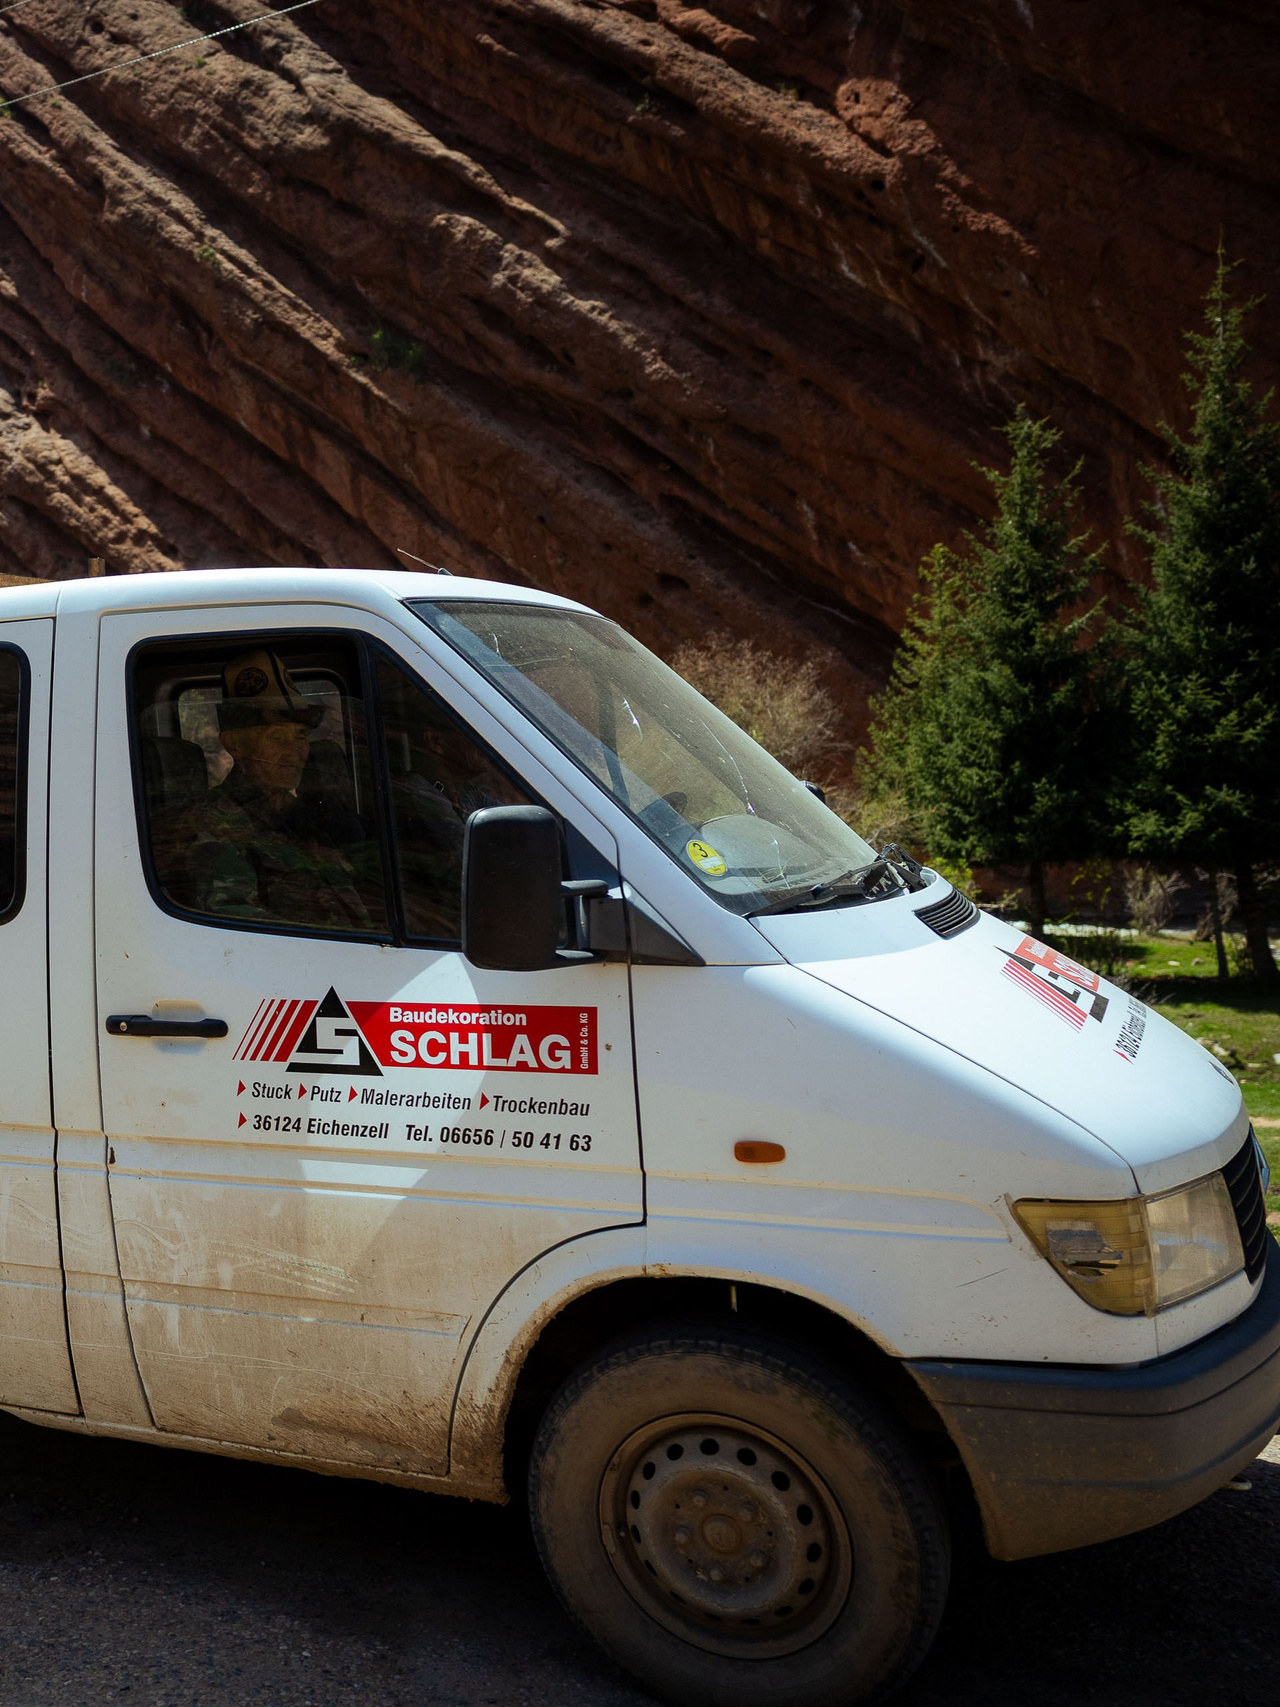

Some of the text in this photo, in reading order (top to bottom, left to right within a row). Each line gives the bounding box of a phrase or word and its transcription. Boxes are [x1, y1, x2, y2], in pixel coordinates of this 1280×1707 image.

[693, 843, 708, 858] 3
[389, 1006, 527, 1026] Baudekoration
[579, 1012, 588, 1024] KG
[579, 1025, 588, 1037] Co.
[389, 1029, 572, 1070] SCHLAG
[580, 1046, 589, 1069] GmbH
[251, 1081, 591, 1116] Stuck Putz Malerarbeiten Trockenbau
[252, 1114, 593, 1152] 36124 Eichenzell Tel. 06656 / 50 41 63
